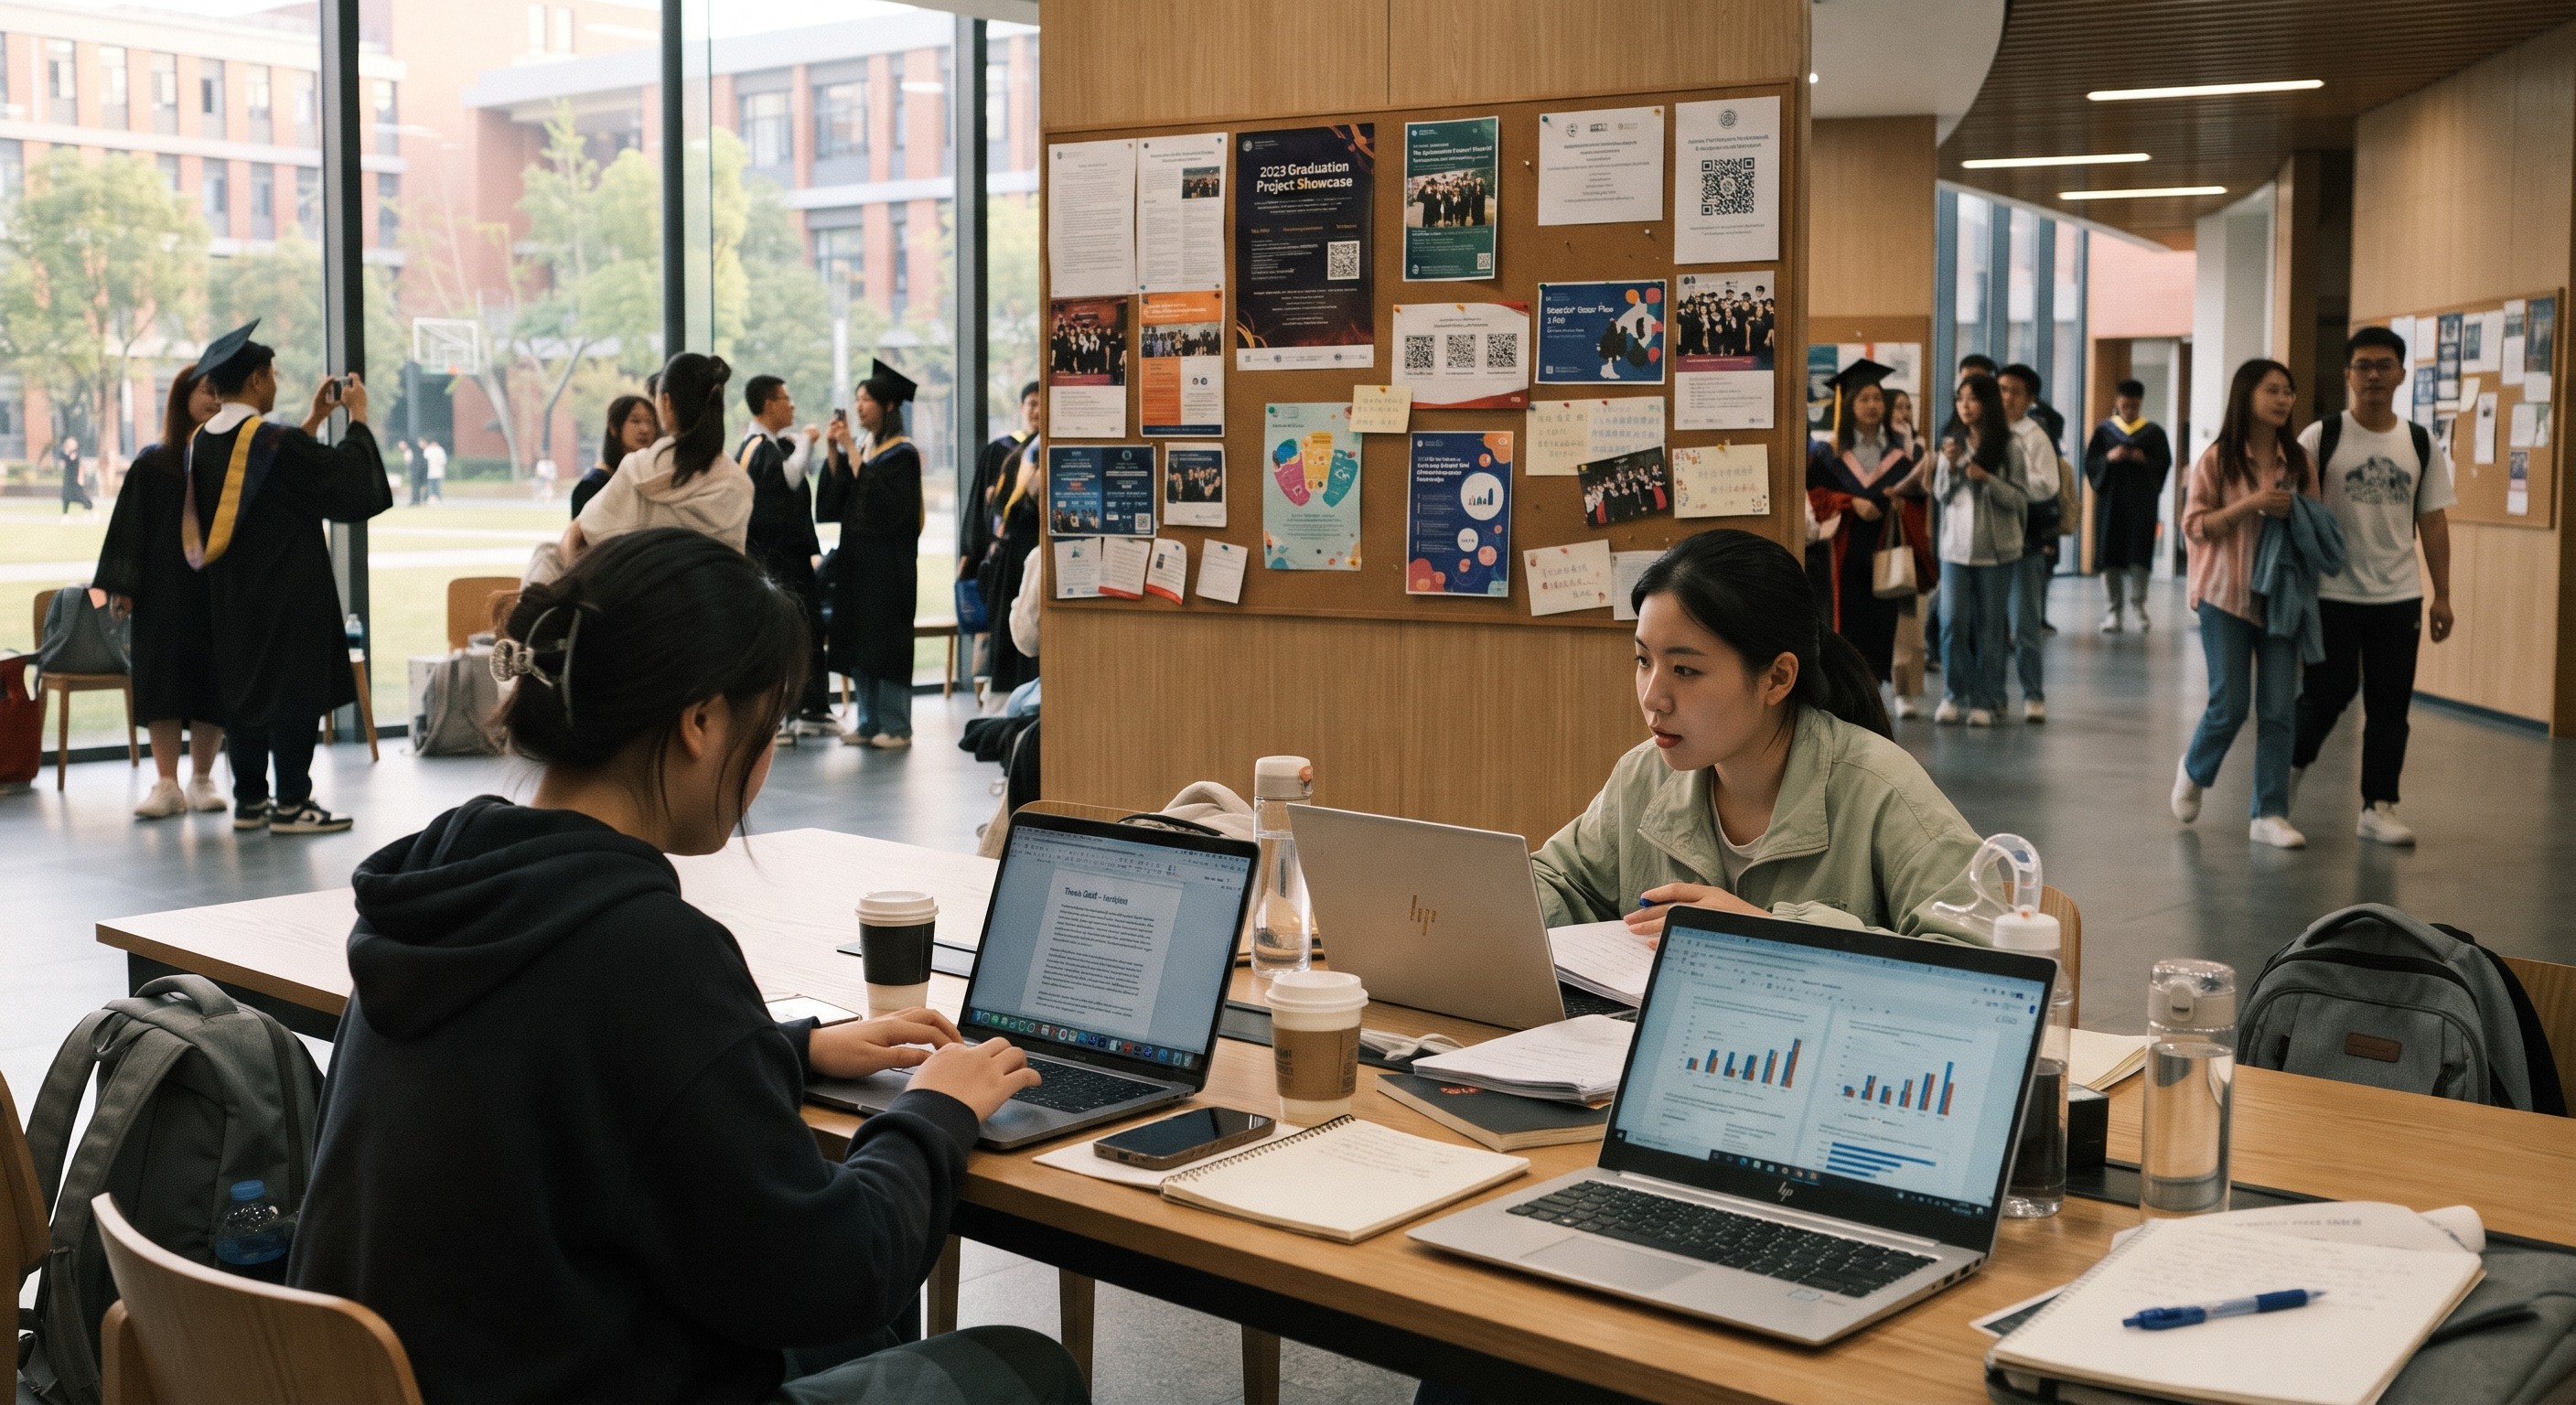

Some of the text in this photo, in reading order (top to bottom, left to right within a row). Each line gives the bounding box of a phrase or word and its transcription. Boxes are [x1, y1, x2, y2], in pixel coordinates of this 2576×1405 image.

[1260, 162, 1349, 177] 2023 Graduation
[1297, 177, 1353, 190] Showcase
[1410, 894, 1436, 936] hp
[1777, 1181, 1794, 1202] hp
